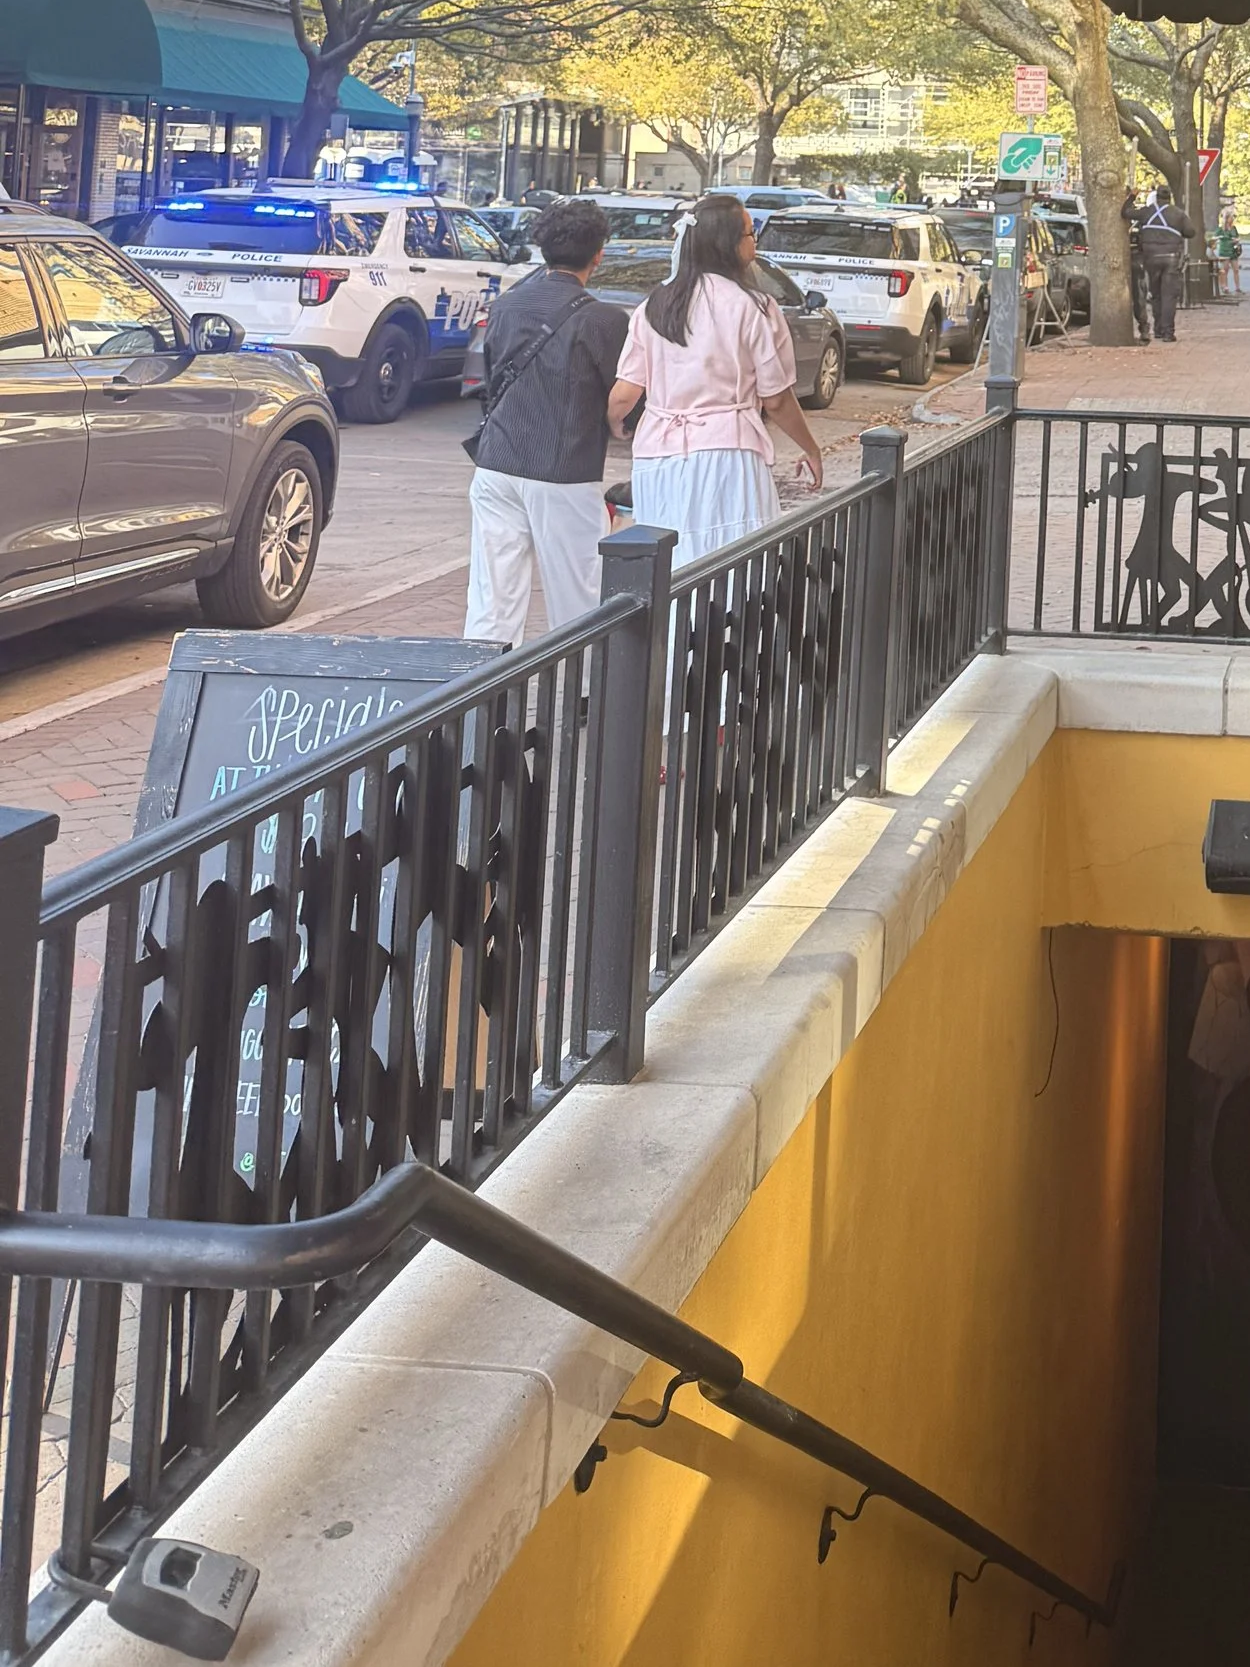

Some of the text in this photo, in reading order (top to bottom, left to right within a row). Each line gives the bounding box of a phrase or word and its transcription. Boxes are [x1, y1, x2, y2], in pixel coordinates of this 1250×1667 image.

[999, 215, 1010, 234] P
[126, 247, 283, 263] SAVANNAH POLICE
[838, 257, 876, 266] POLICE
[369, 270, 388, 287] 911
[209, 765, 247, 801] AT
